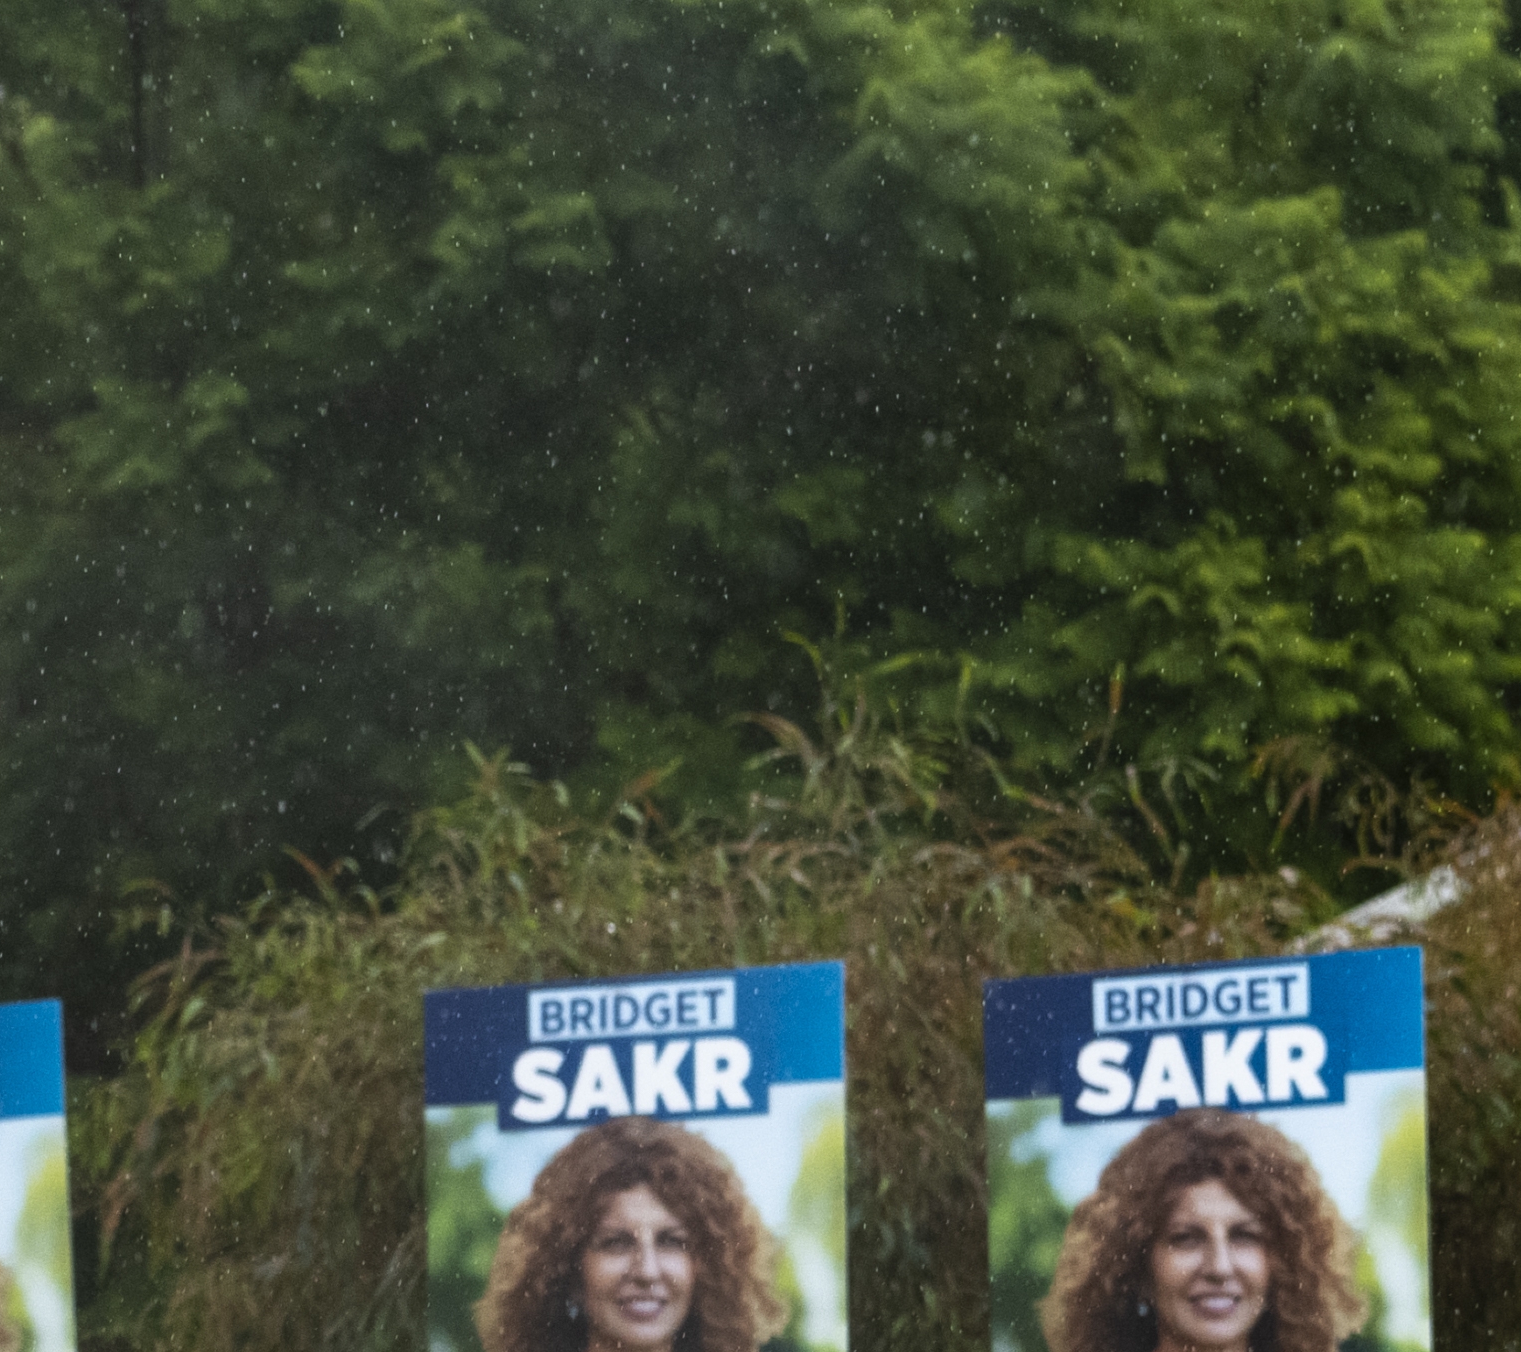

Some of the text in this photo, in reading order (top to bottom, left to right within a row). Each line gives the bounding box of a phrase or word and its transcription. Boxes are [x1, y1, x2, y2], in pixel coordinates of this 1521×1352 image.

[540, 988, 726, 1035] BRIDGET
[1105, 974, 1299, 1026] BRIDGET
[511, 1036, 754, 1124] SAKR
[1076, 1024, 1329, 1117] SAKR
